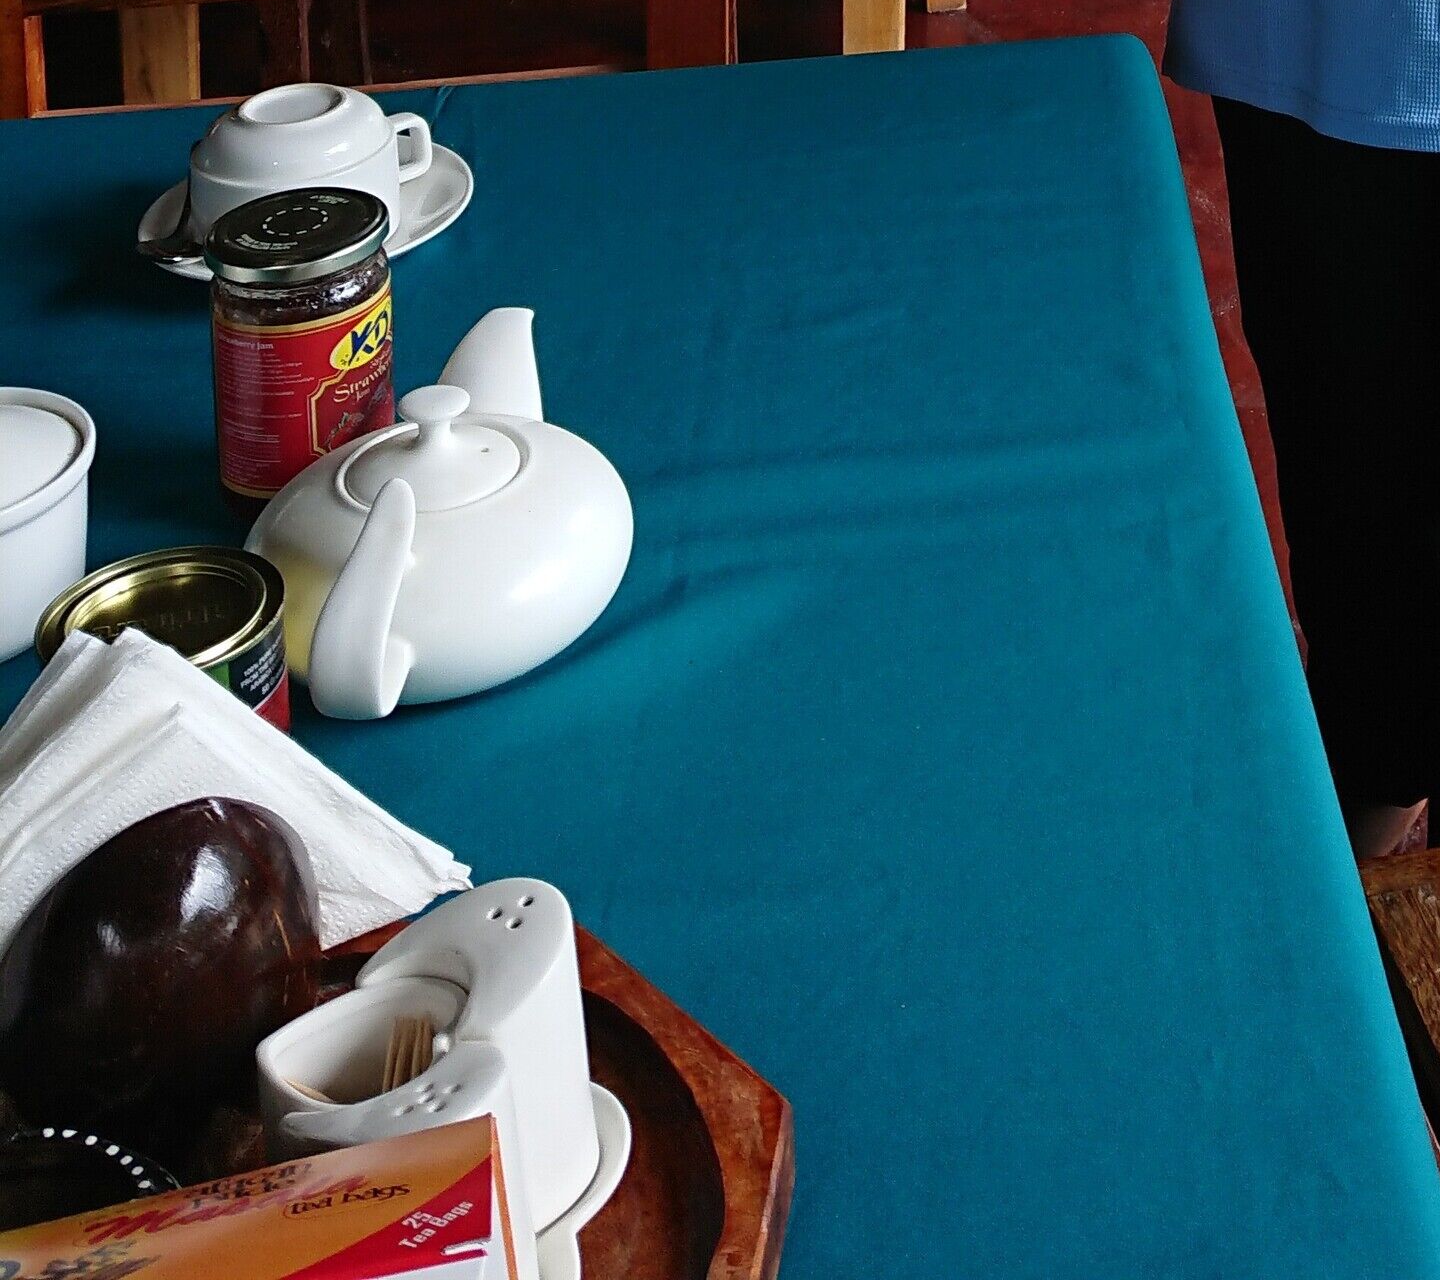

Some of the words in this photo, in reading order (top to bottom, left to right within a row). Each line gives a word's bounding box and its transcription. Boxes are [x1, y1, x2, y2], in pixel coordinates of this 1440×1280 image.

[398, 1228, 437, 1249] Tea
[428, 1201, 474, 1228] Bags
[401, 1210, 433, 1229] 25
